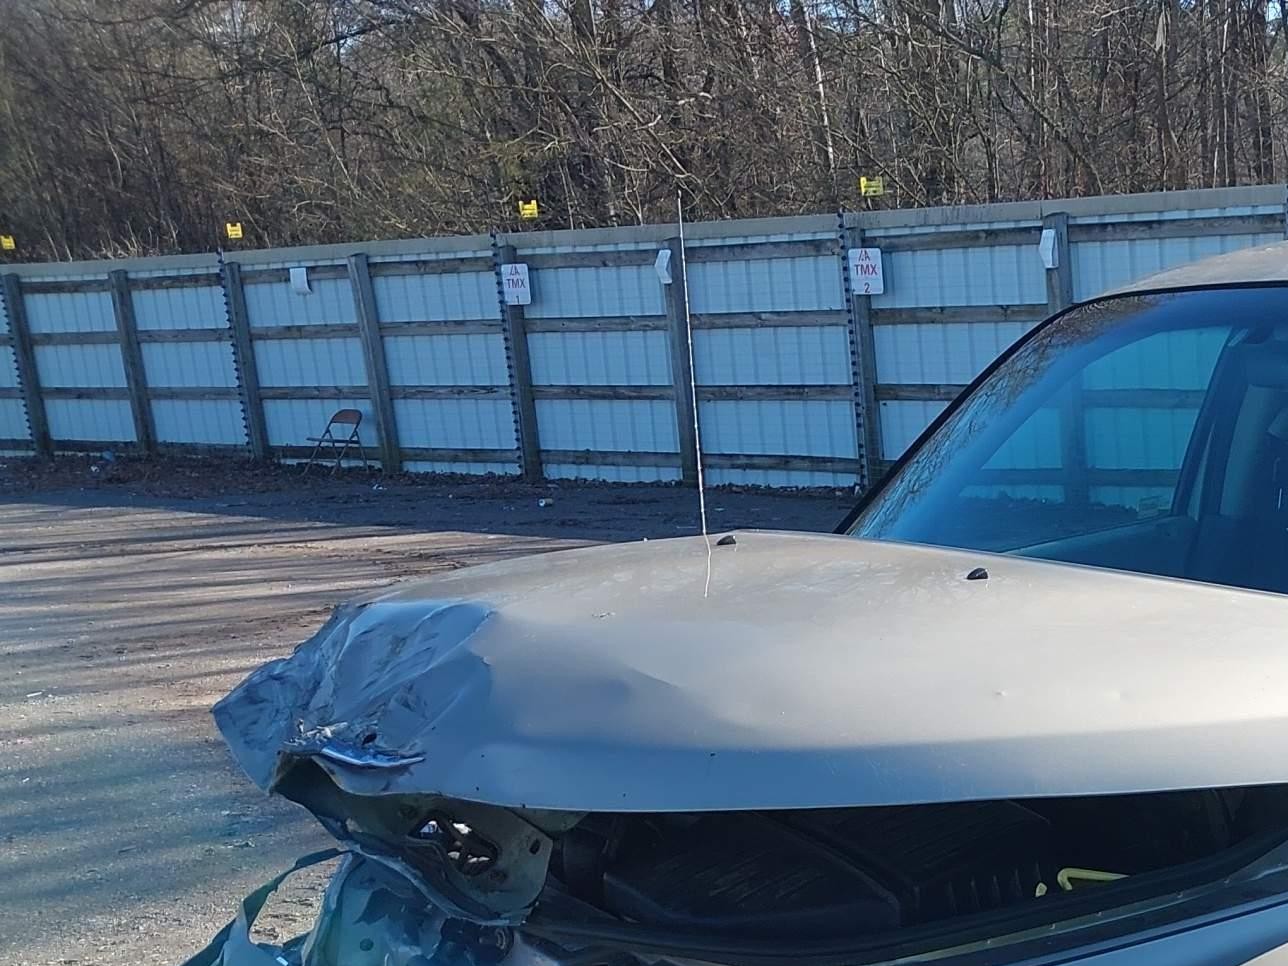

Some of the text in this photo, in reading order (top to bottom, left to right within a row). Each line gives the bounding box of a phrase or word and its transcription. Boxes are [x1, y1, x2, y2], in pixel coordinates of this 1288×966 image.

[854, 263, 878, 276] TMX
[505, 278, 526, 289] TMX
[863, 282, 871, 294] 2
